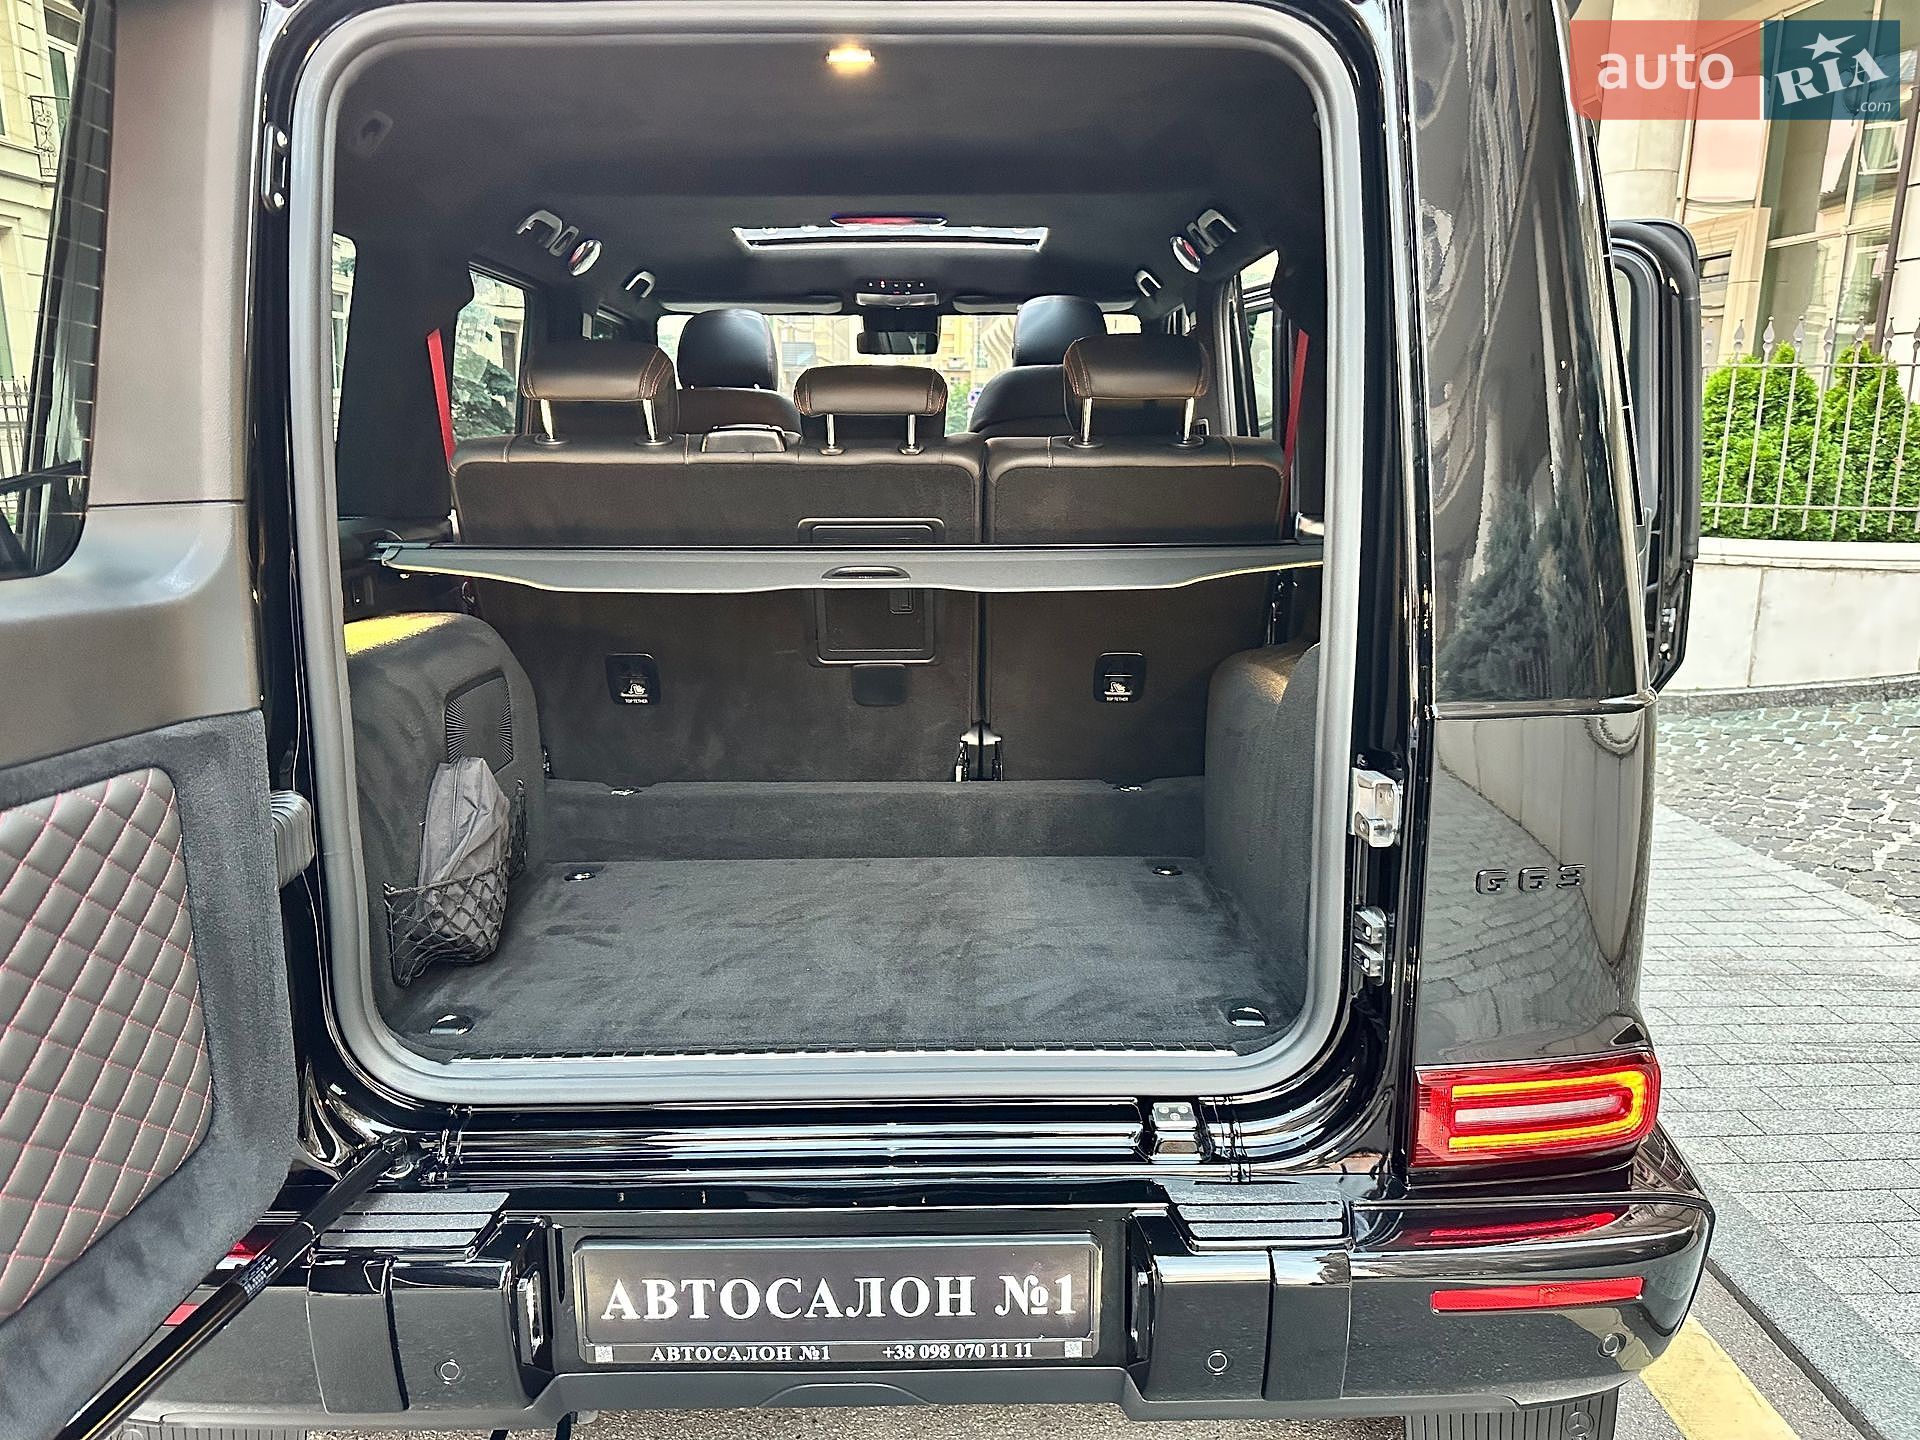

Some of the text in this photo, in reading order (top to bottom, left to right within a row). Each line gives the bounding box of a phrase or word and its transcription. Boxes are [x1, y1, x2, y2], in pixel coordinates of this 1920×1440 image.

[600, 1274, 1077, 1321] АВТОСАЛОН №1
[650, 1345, 831, 1362] АВТОСАЛОН №1
[882, 1343, 1033, 1360] +38 098 070 11 11
